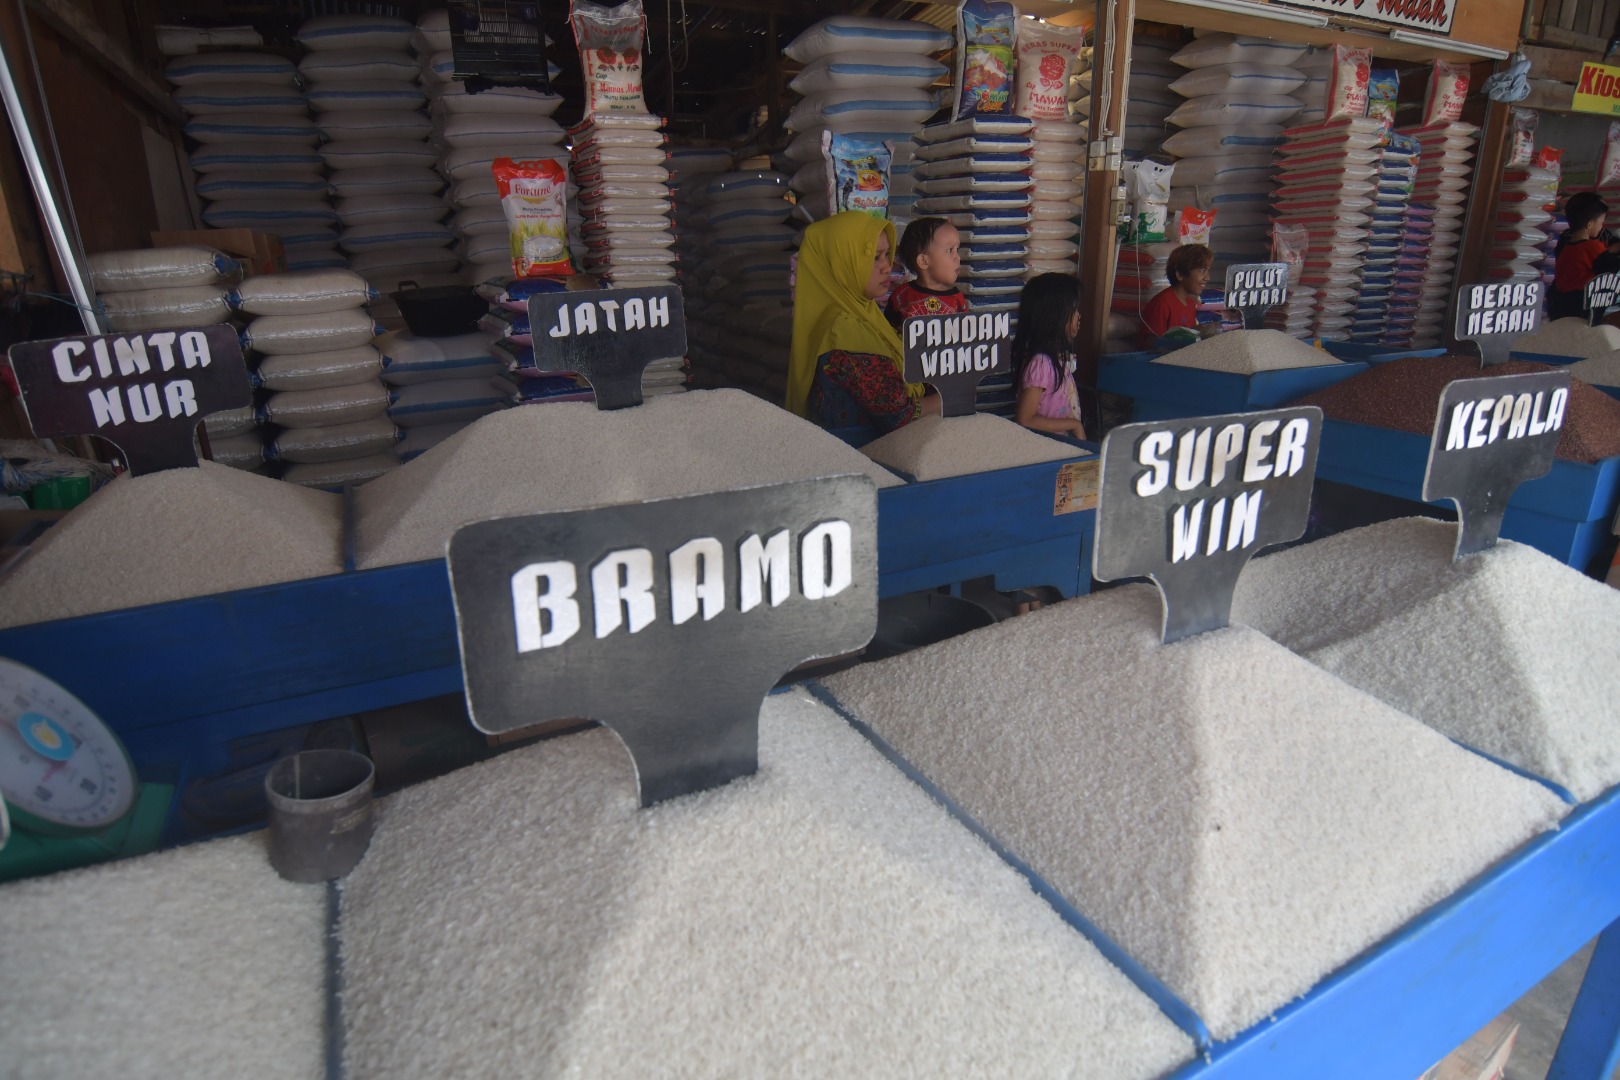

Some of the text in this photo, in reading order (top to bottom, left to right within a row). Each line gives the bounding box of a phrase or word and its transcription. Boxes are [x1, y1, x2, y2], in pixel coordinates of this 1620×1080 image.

[1021, 41, 1048, 53] BERAS
[515, 183, 552, 198] Fortune
[1234, 268, 1284, 290] PULUT
[1470, 283, 1539, 309] BERAS
[1228, 288, 1287, 308] KENARI
[1590, 292, 1615, 308] WANGI
[549, 296, 670, 338] JATAH
[909, 312, 1009, 349] PANDAN
[1467, 309, 1536, 336] MERAH
[52, 331, 212, 383] CINTA
[920, 343, 998, 379] WANGI
[88, 379, 199, 428] NUR
[1445, 387, 1568, 452] KEPALA
[1136, 417, 1309, 497] SUPER
[1172, 489, 1263, 564] WIN
[511, 519, 853, 653] BRAMO
